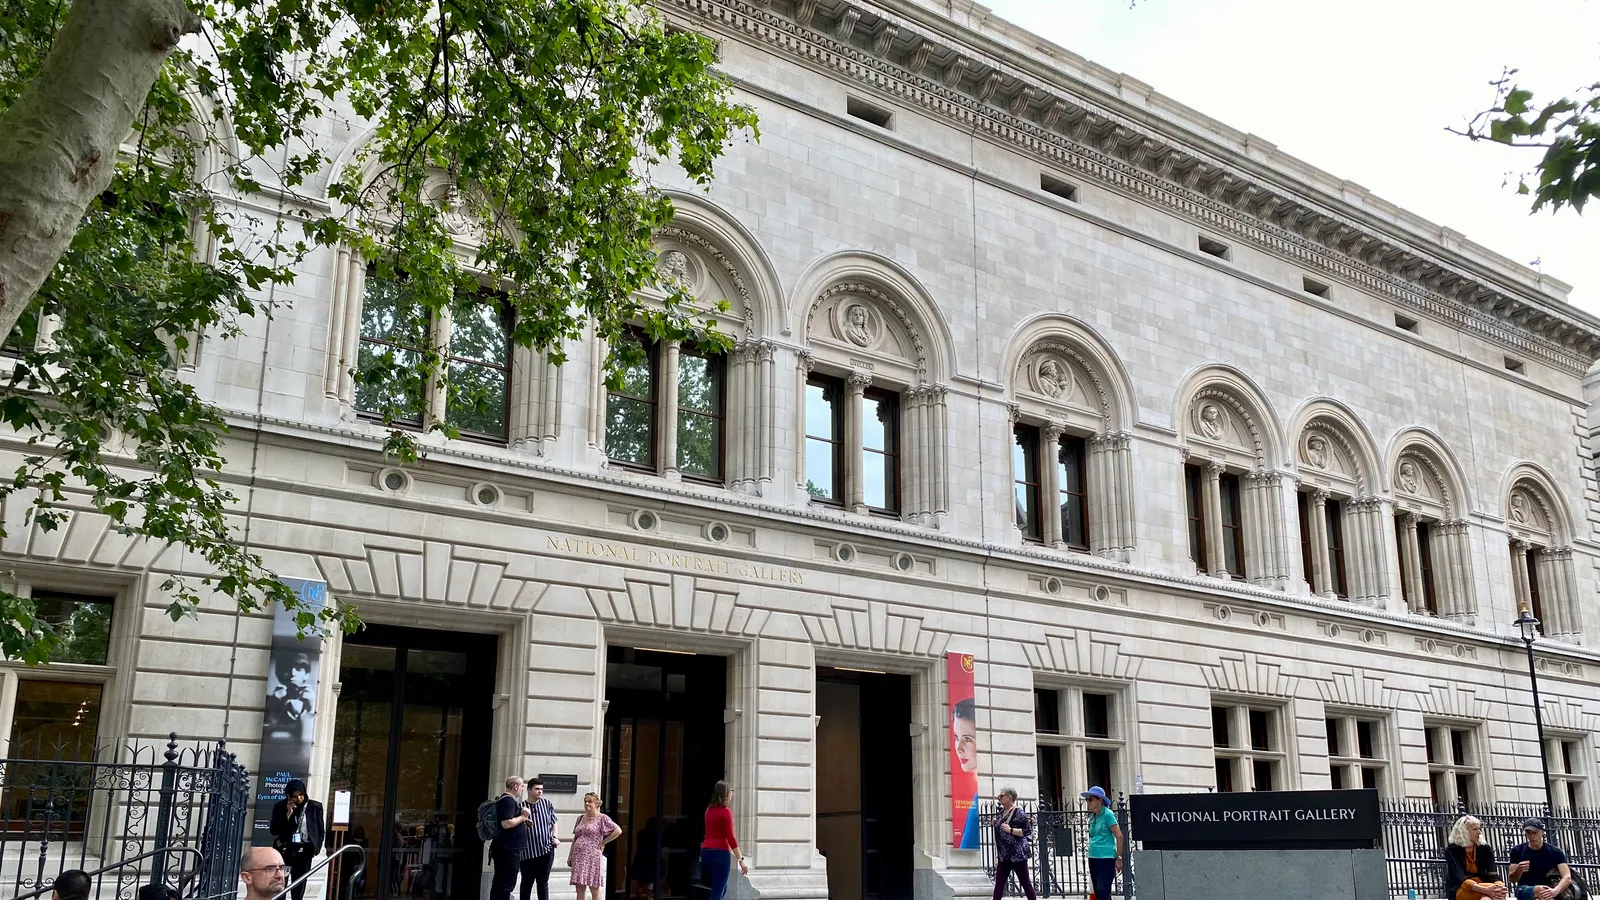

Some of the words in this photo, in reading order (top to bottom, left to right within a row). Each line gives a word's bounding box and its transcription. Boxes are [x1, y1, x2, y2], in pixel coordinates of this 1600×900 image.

[546, 536, 640, 561] NATIONAL
[648, 550, 732, 575] PORTRAIT
[738, 564, 806, 585] GALLERY
[1150, 811, 1220, 823] NATIONAL
[1223, 809, 1291, 822] PORTRAIT
[1295, 808, 1356, 821] GALLERY
